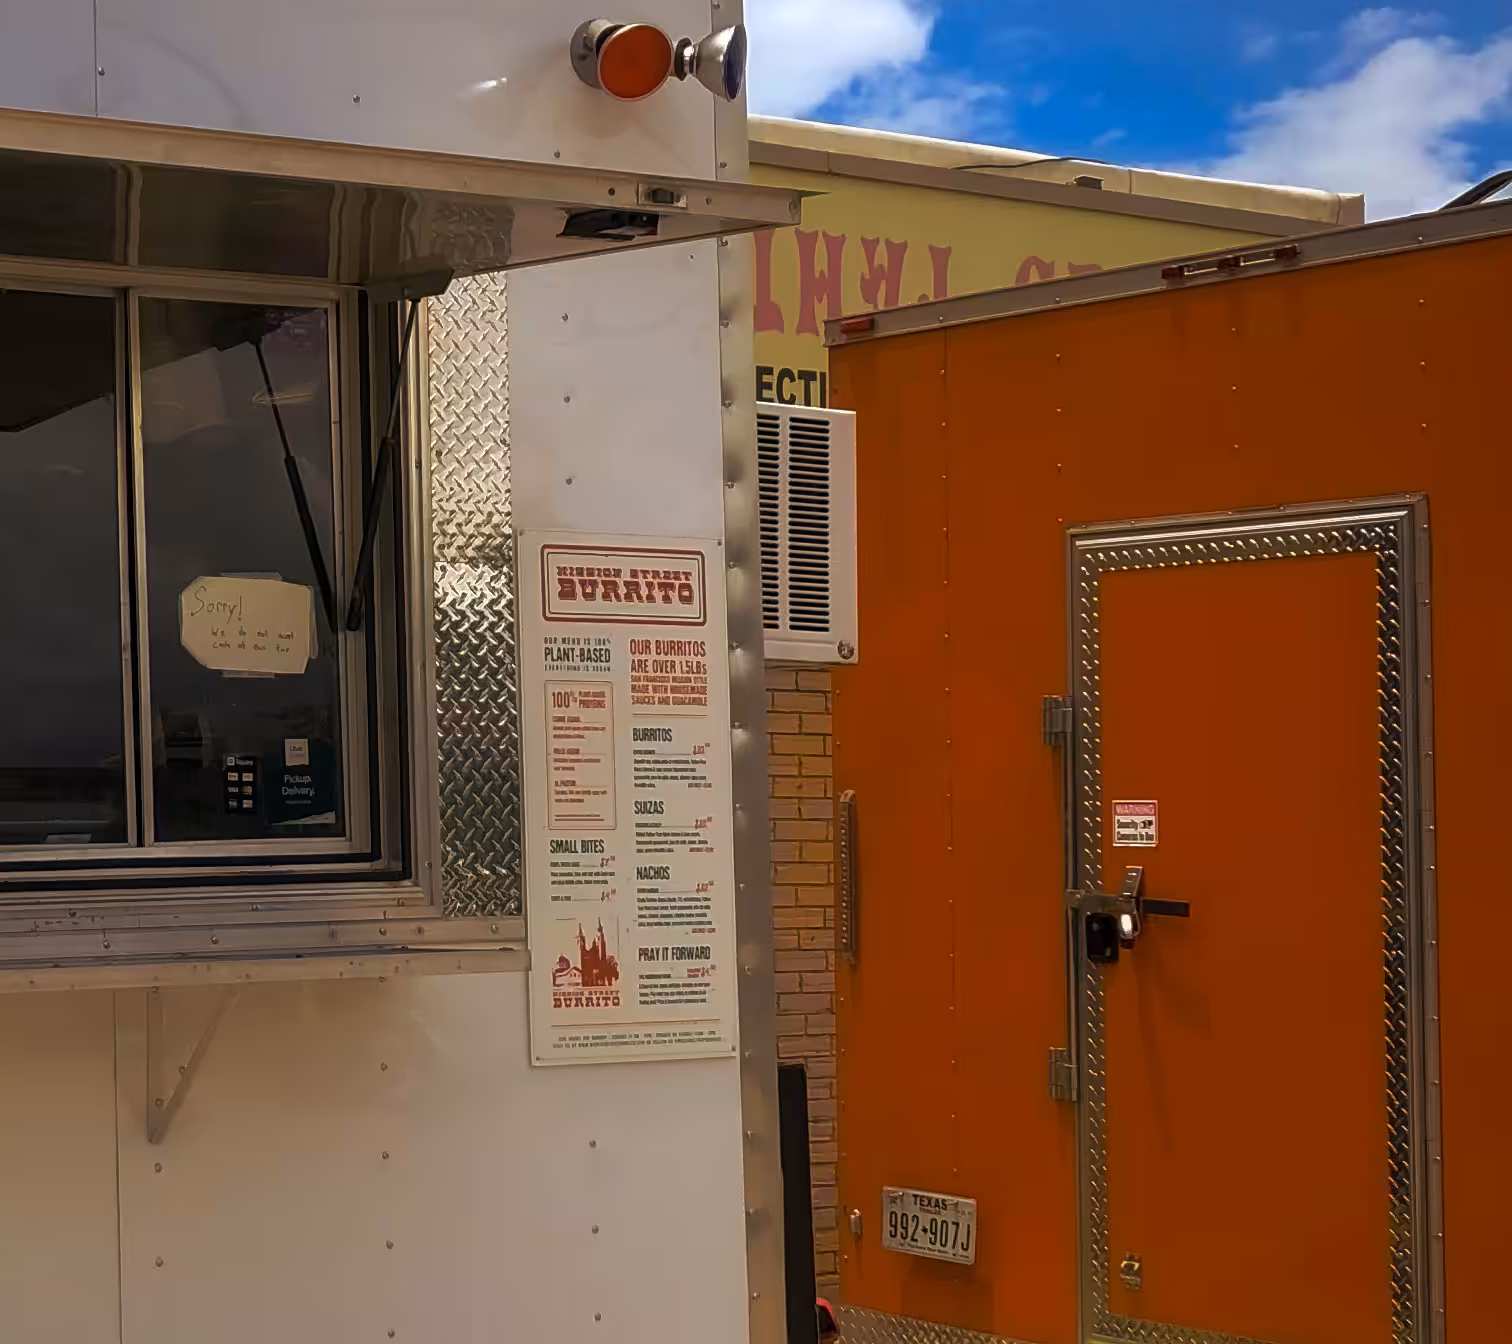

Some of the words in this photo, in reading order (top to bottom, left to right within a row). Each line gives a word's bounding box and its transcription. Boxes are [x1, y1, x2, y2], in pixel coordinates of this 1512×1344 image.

[557, 578, 694, 605] BURRITO
[191, 585, 242, 625] Sorry!
[544, 647, 611, 663] PLANT-BASED
[629, 638, 652, 655] OUR
[655, 639, 706, 657] BURRITOS
[630, 659, 649, 674] ARE
[653, 659, 676, 674] OVER
[632, 727, 673, 742] BURRITOS
[634, 800, 665, 815] SUIZAS
[549, 839, 579, 854] SMALL
[580, 838, 605, 854] BITES
[636, 866, 670, 881] NACHOS
[638, 947, 660, 962] PRAY
[662, 947, 669, 961] IT
[671, 946, 711, 961] FORWARD
[552, 996, 620, 1009] BURRITO
[912, 1194, 948, 1211] TEXAS
